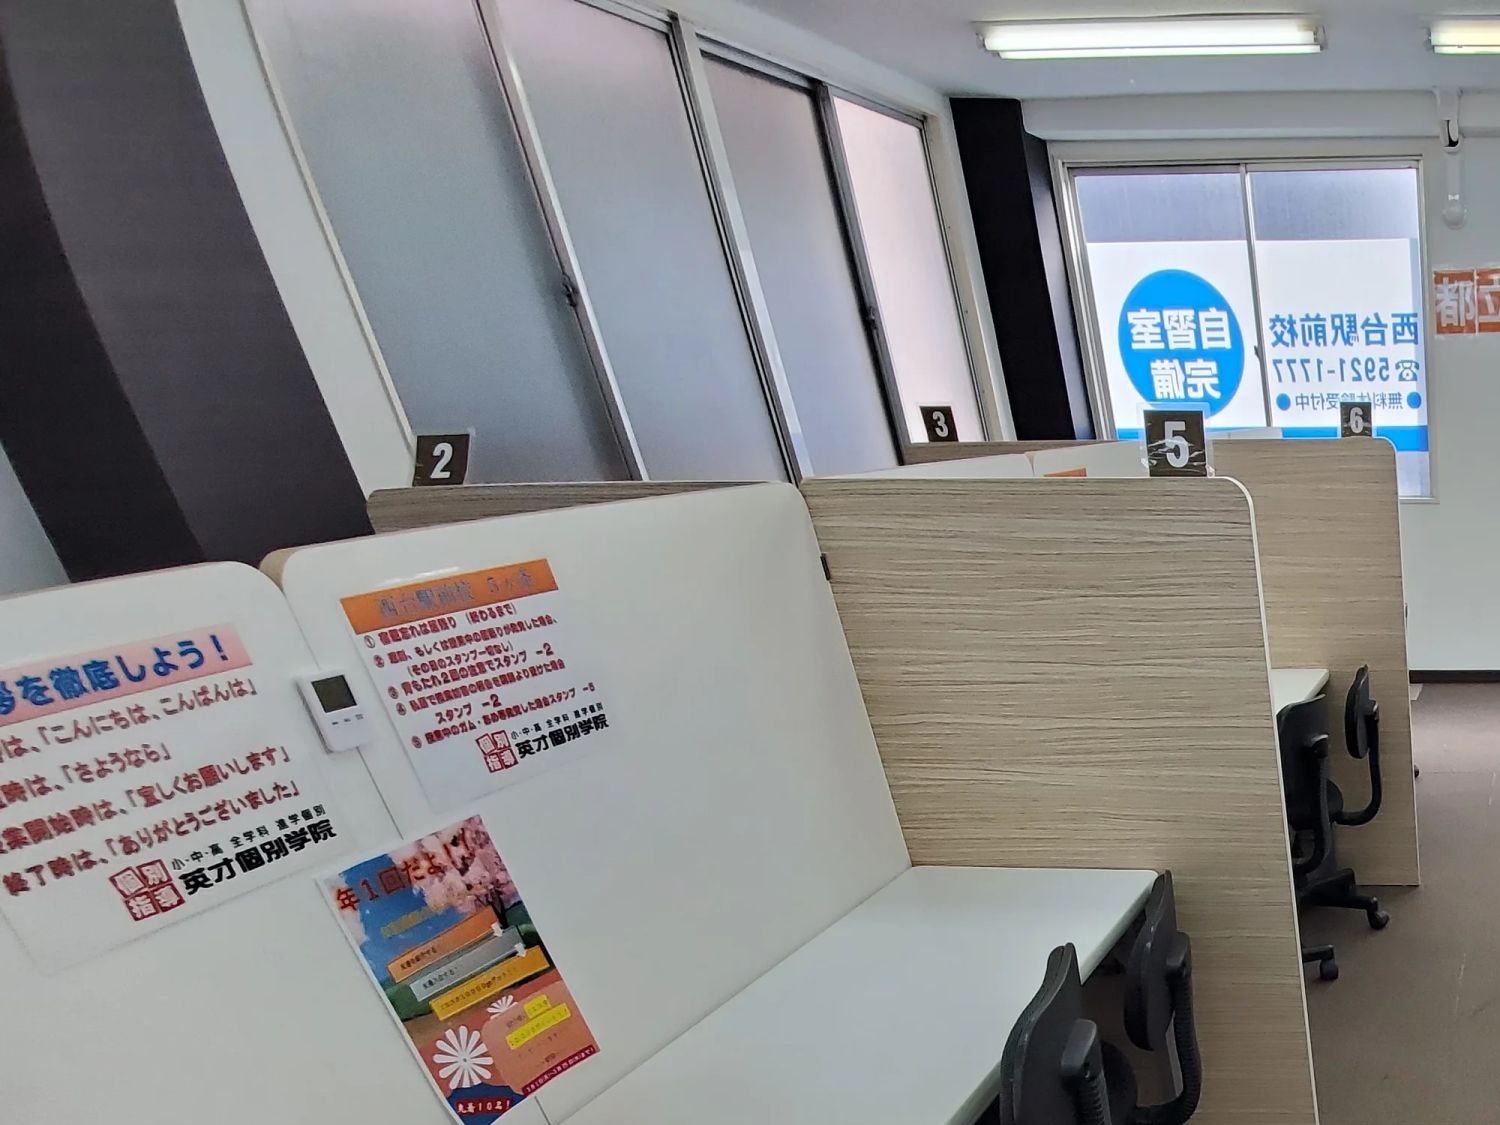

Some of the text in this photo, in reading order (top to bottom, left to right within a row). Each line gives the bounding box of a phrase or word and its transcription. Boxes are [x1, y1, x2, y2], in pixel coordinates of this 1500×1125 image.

[934, 410, 950, 438] 3
[1350, 407, 1364, 433] 6
[430, 443, 452, 480] 2
[1164, 421, 1190, 468] 5
[515, 713, 610, 758] 英才個別学院
[0, 742, 172, 809] 時は、「さようなら」
[178, 818, 337, 896] 英才個別学院
